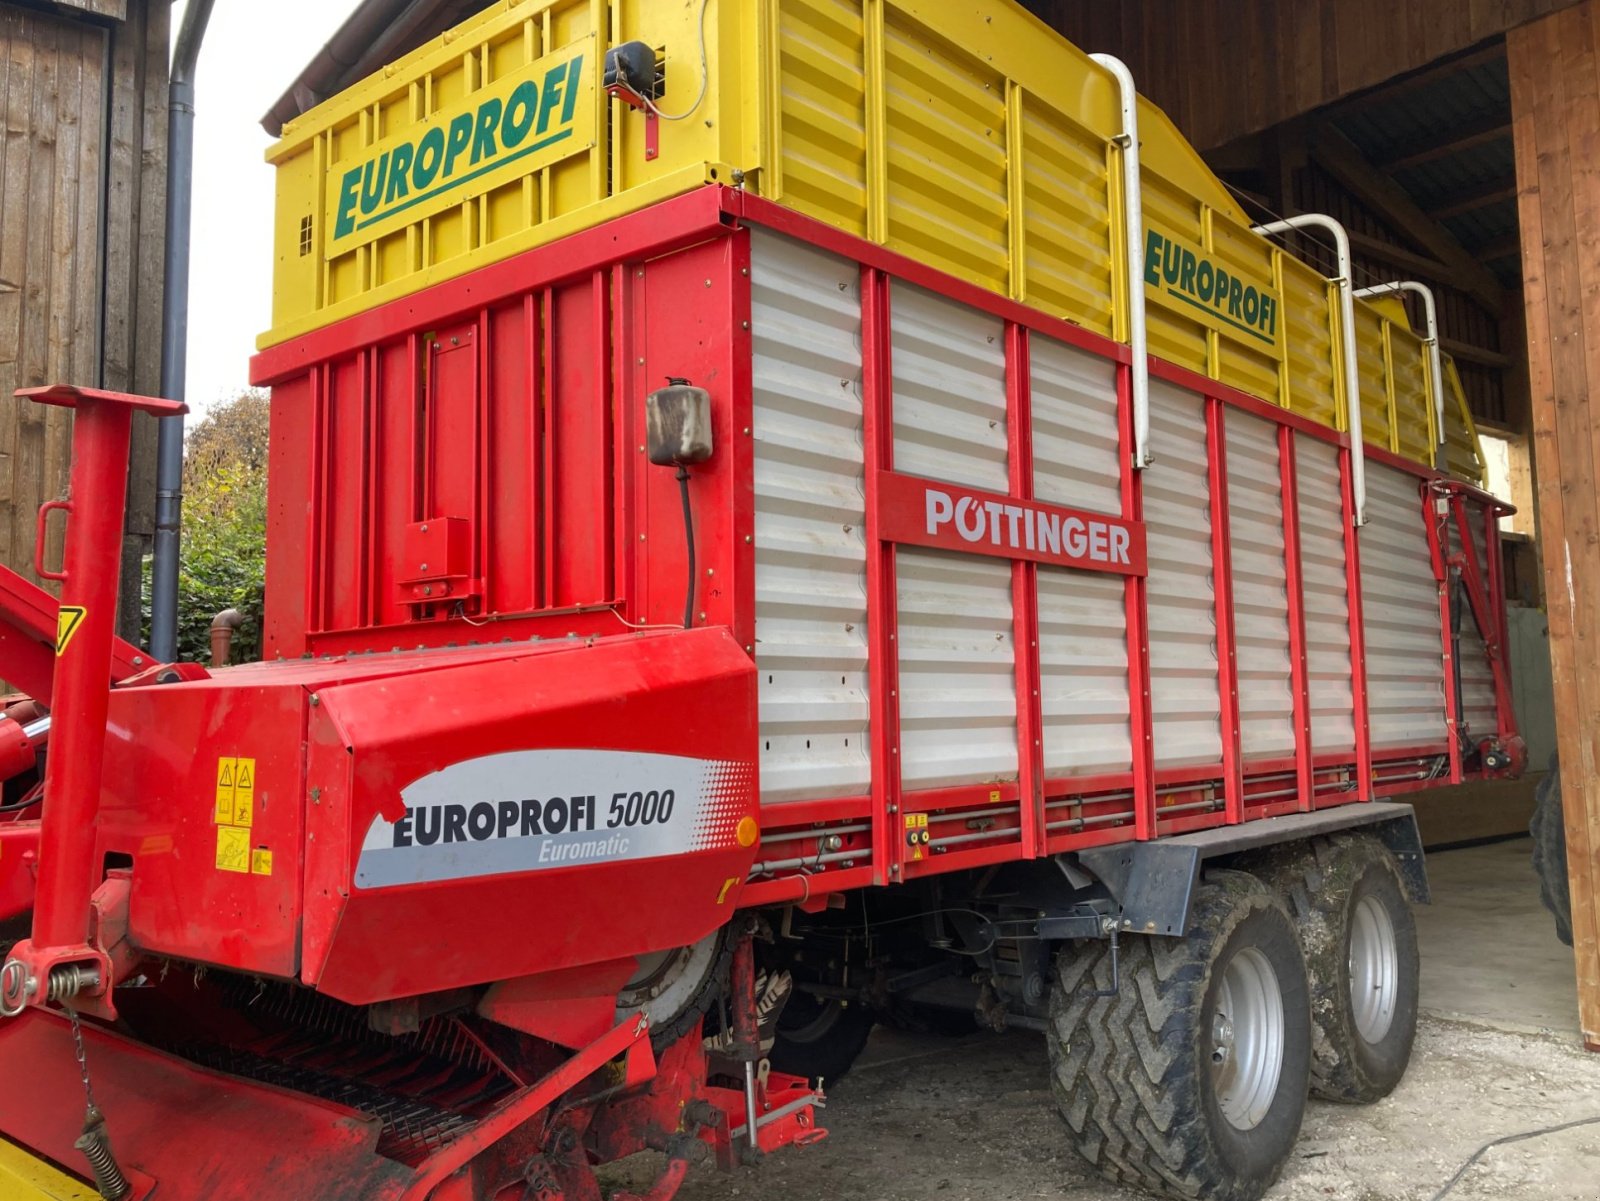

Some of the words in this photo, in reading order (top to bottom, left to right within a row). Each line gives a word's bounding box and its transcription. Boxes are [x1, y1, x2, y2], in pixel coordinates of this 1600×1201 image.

[334, 54, 583, 240] EUROPROFI
[1144, 229, 1276, 336] EUROPROFI
[393, 795, 595, 848] EUROPROFI
[607, 789, 675, 828] 5000
[538, 833, 630, 863] Euromatic
